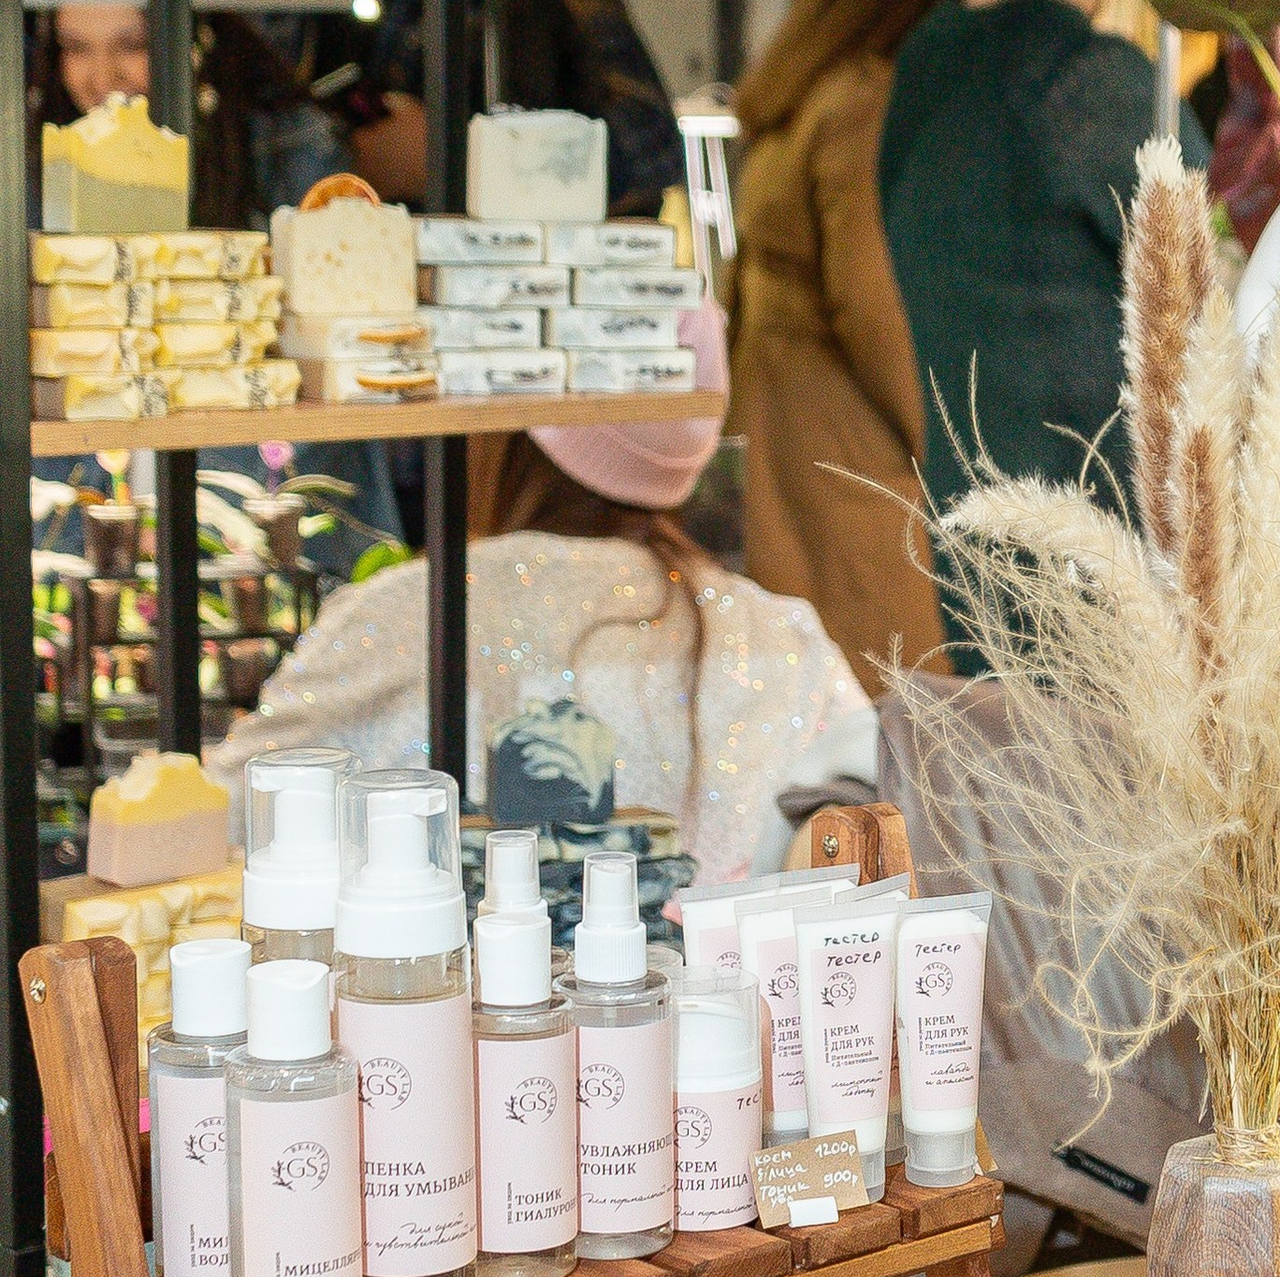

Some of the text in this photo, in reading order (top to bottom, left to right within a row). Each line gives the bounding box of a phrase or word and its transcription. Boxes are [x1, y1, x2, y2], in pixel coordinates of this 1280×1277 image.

[826, 950, 882, 968] тестер
[779, 974, 798, 991] GS
[925, 972, 946, 989] GS
[829, 982, 849, 999] GS
[924, 1015, 956, 1026] КРЕМ
[830, 1024, 860, 1037] КРЕМ
[924, 1026, 969, 1040] ДЛЯ РУК
[830, 1036, 875, 1052] ДЛЯ РУК
[369, 1059, 409, 1081] BEAUTY
[366, 1074, 399, 1096] GS
[584, 1078, 613, 1097] GS
[519, 1093, 548, 1112] GS
[675, 1120, 701, 1138] GS
[286, 1158, 318, 1180] GS
[364, 1160, 427, 1177] ПЕНКА
[580, 1162, 638, 1176] ТОНИК
[675, 1160, 718, 1174] КРЕМ
[364, 1182, 401, 1199] ДЛЯ
[675, 1173, 750, 1192] ДЛЯ ЛИЦА
[514, 1187, 563, 1207] ТОНИК
